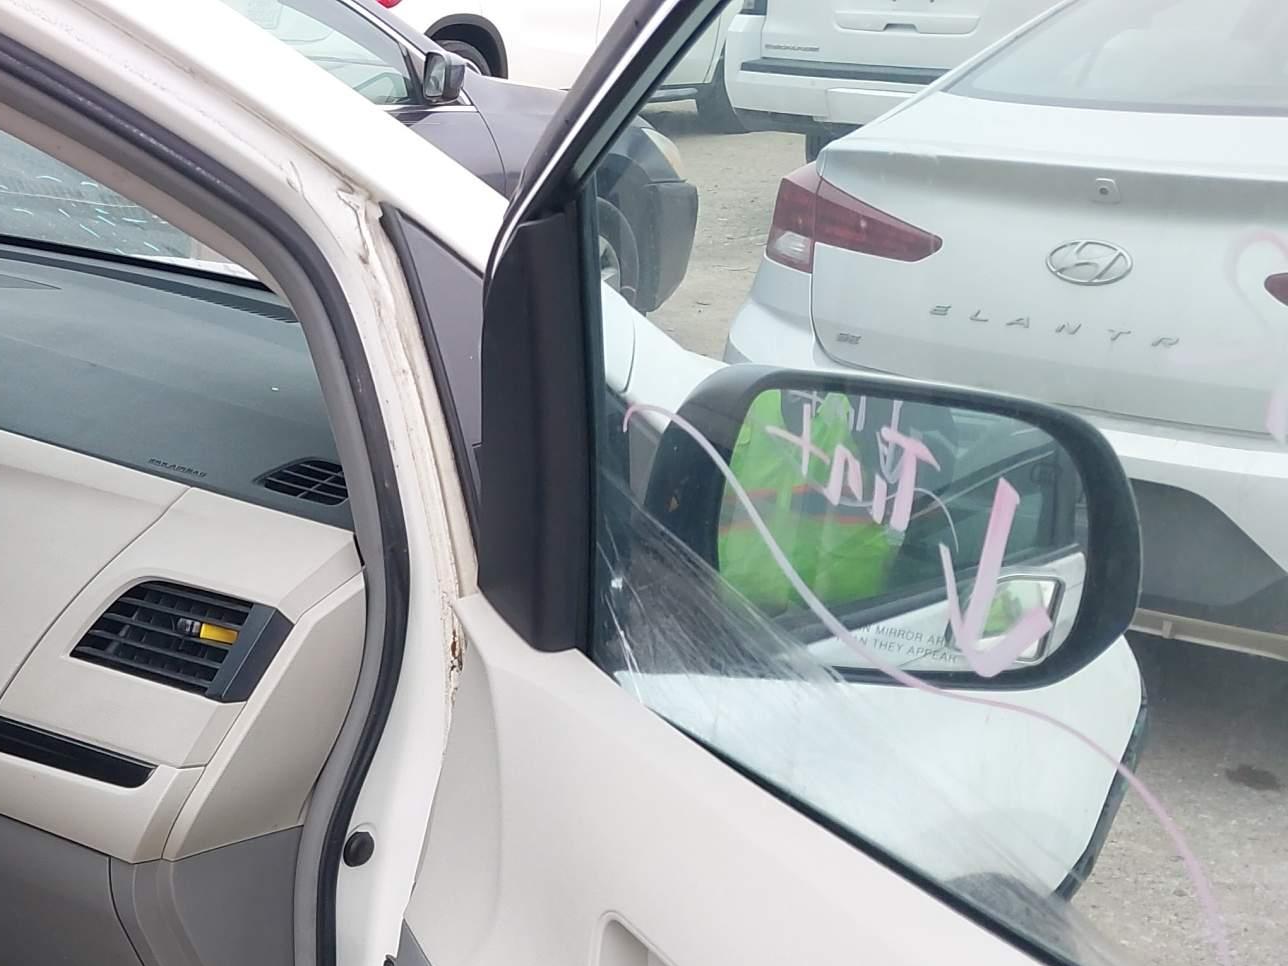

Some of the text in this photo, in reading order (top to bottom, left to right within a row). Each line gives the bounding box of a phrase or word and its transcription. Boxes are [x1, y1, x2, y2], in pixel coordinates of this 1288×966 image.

[876, 625, 923, 642] MIRROR
[873, 638, 902, 653] THEY
[907, 645, 957, 663] APPEAR
